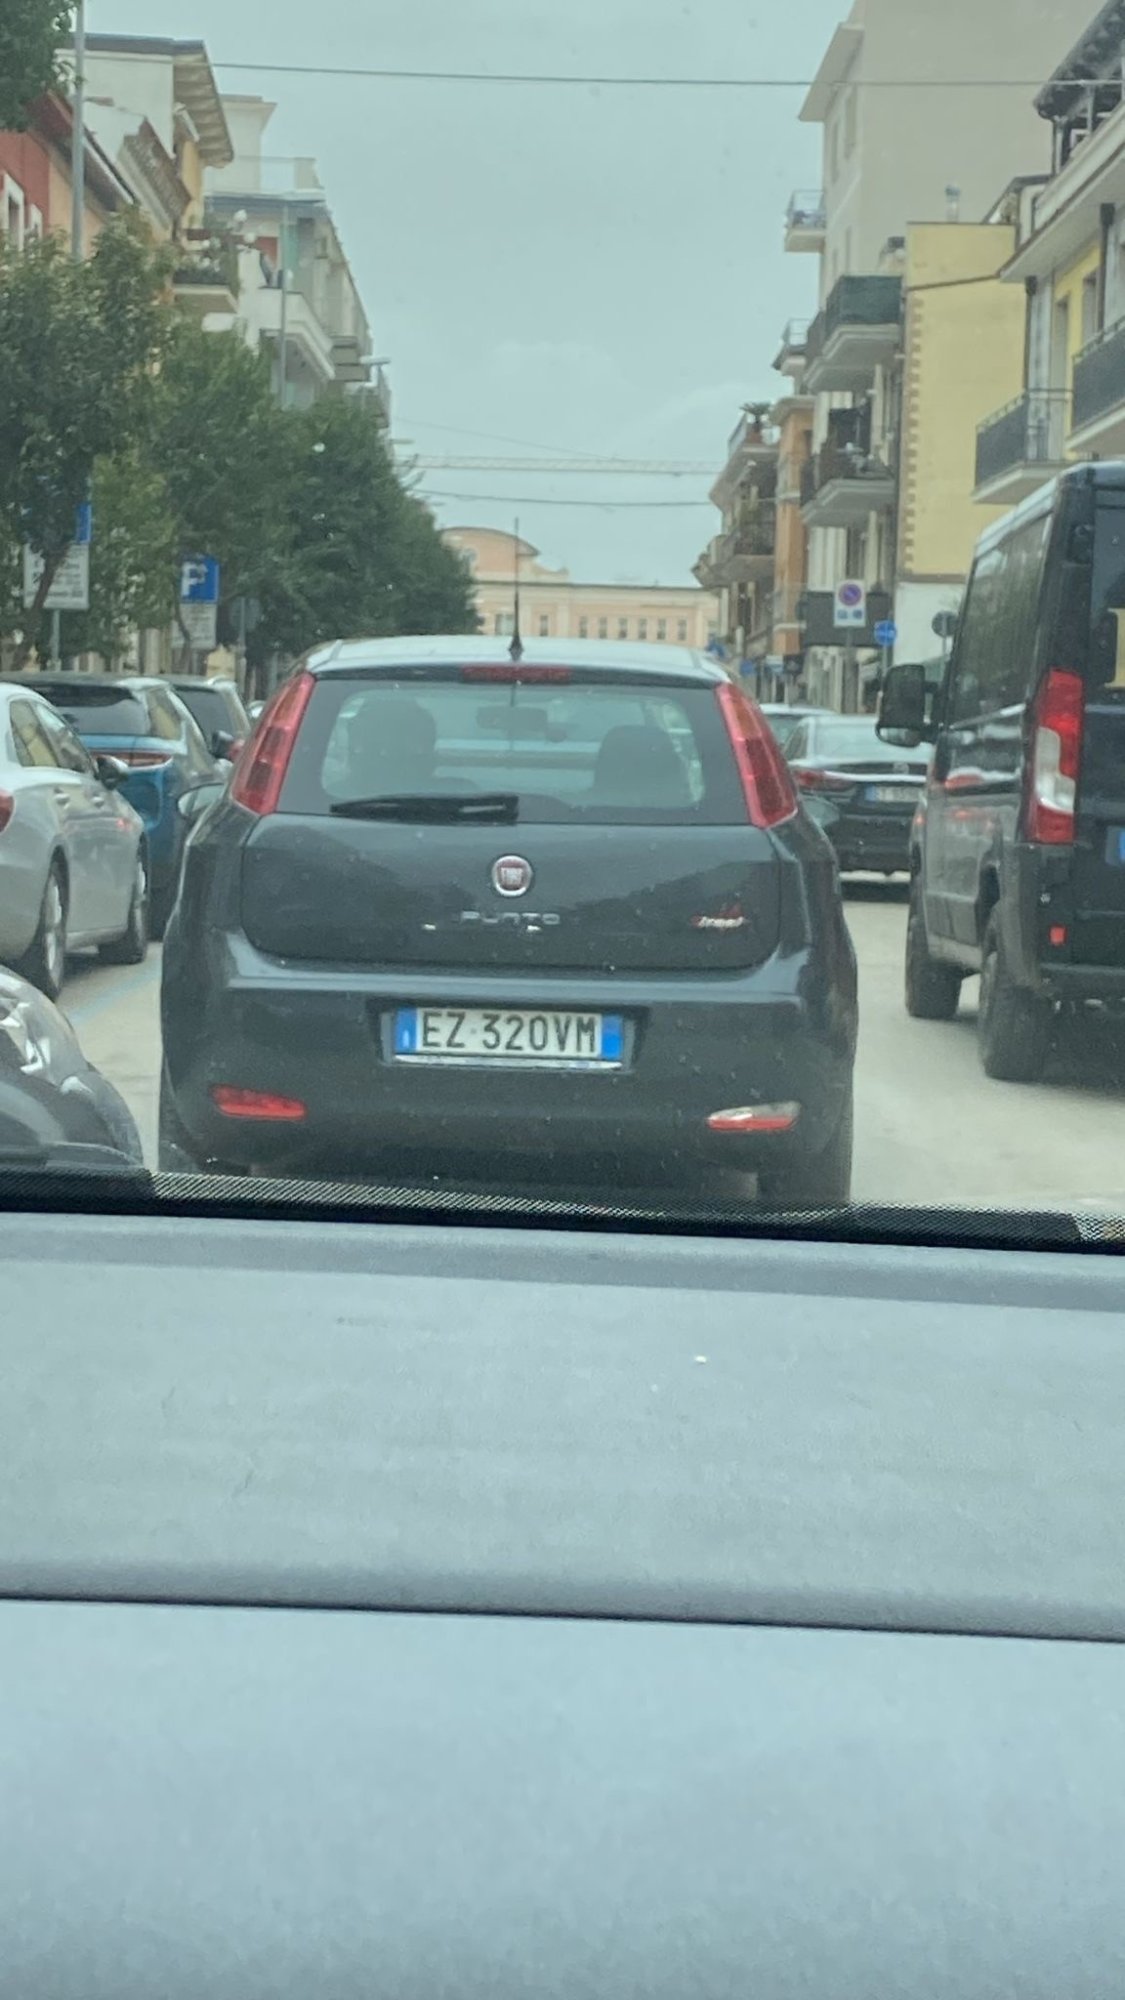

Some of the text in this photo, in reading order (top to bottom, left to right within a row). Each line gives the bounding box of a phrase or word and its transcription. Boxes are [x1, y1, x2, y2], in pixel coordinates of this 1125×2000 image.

[182, 561, 208, 595] P
[422, 1011, 596, 1053] EZ 320VM
